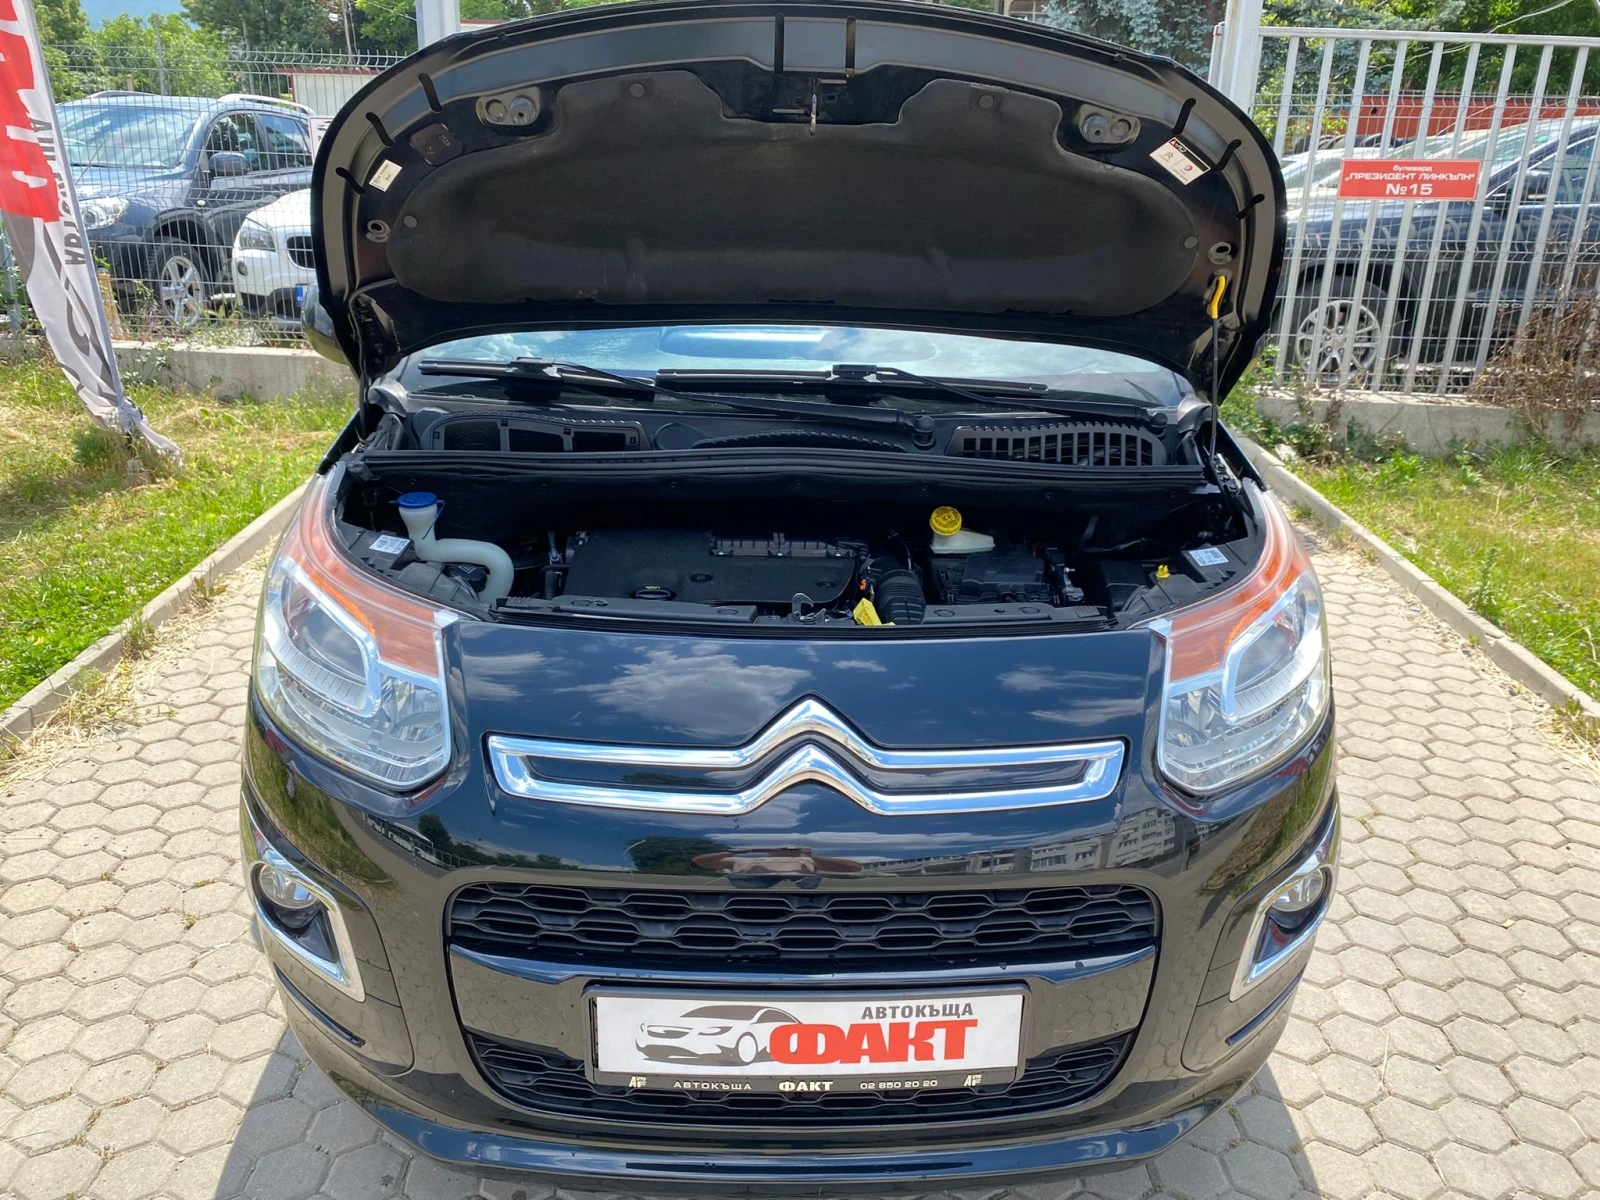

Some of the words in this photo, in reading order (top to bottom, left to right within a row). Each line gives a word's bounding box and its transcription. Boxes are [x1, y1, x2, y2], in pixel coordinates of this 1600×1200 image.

[861, 1002, 973, 1020] АВТОКЪЩА
[769, 1019, 978, 1065] ФАКТ
[778, 1081, 833, 1092] ФАКТ
[860, 1082, 875, 1090] 02
[878, 1081, 901, 1089] 850
[904, 1080, 920, 1088] 20
[922, 1079, 938, 1087] 20
